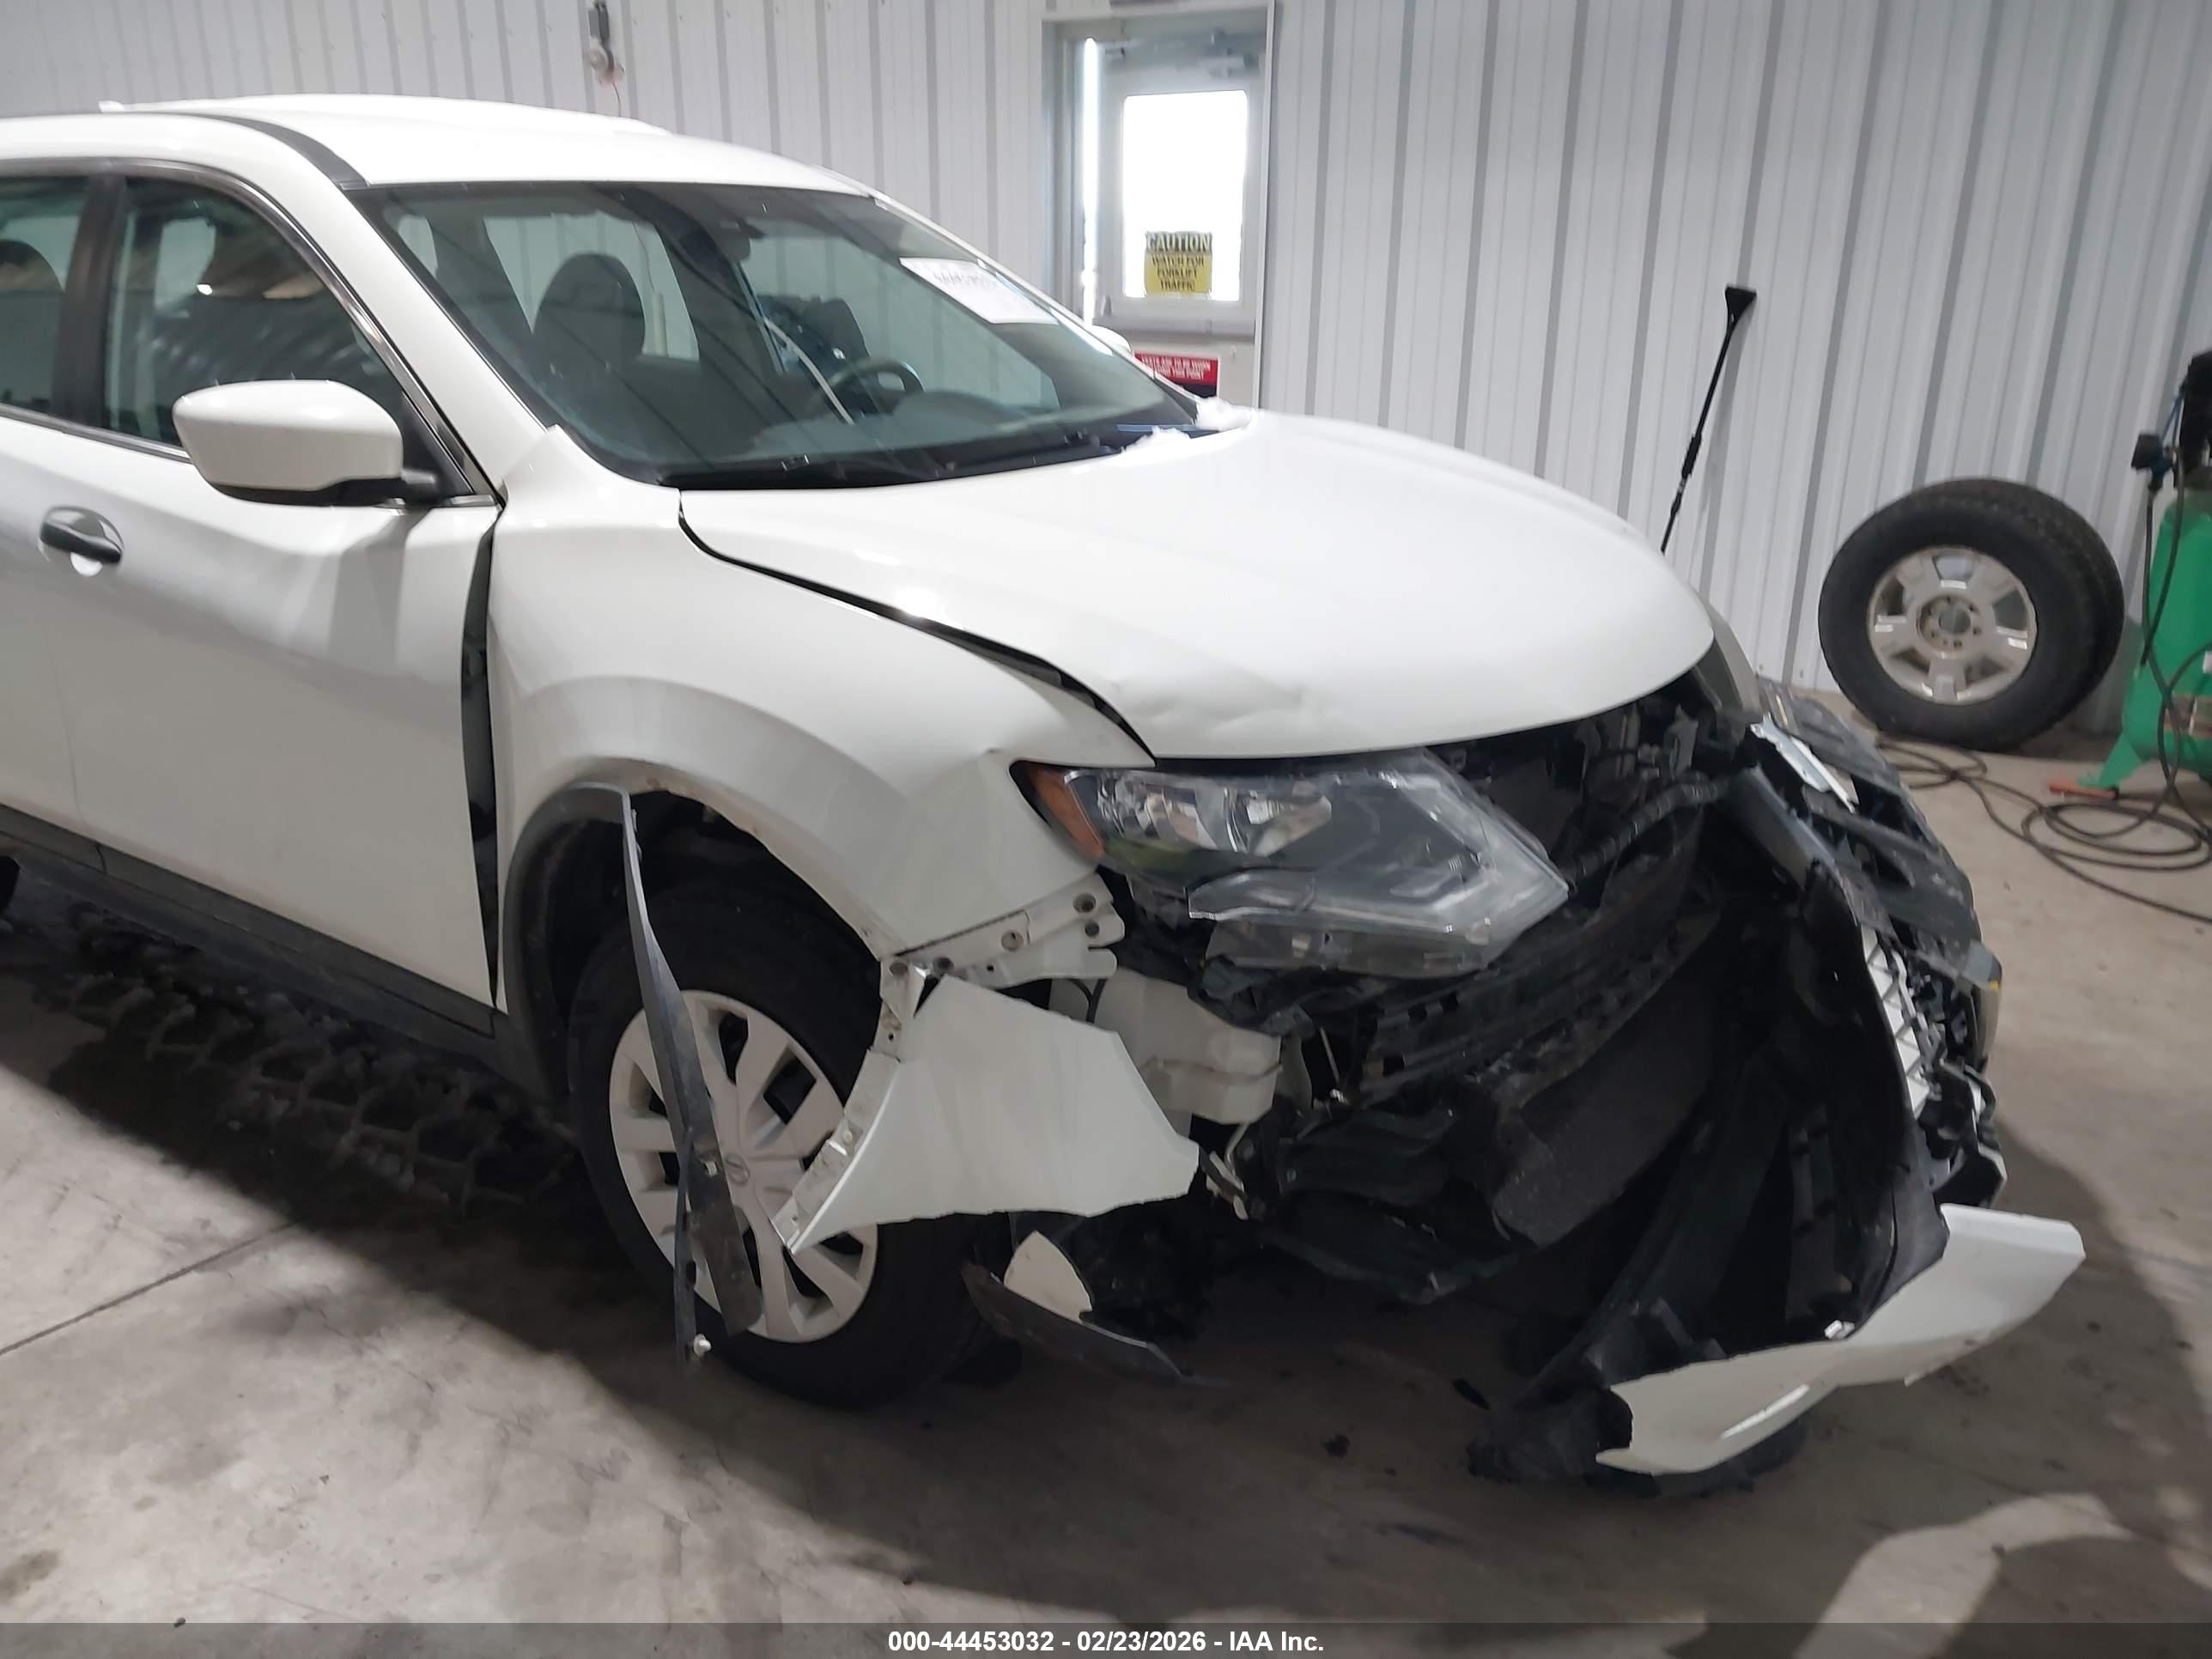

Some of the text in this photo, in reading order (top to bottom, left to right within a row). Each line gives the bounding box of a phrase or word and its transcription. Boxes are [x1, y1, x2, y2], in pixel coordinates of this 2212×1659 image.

[1146, 233, 1209, 251] CAUTION
[1152, 254, 1204, 266] WATCH FOR
[1156, 266, 1197, 278] FORKLIFT
[1159, 278, 1194, 291] TRAFFIC
